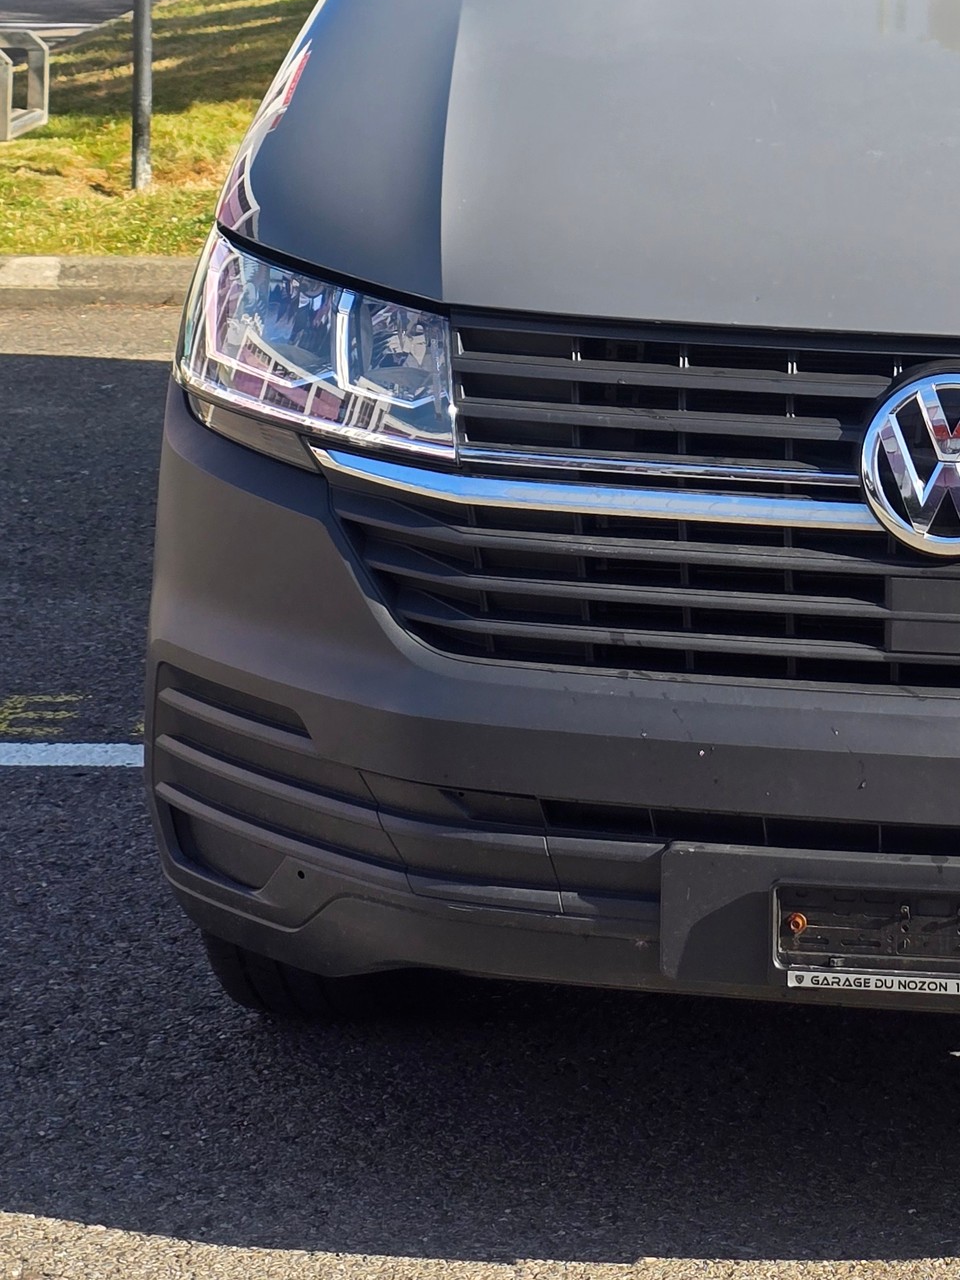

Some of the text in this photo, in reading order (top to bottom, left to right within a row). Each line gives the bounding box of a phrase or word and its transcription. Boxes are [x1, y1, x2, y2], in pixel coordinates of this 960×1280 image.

[810, 975, 871, 989] GARAGE
[874, 978, 894, 989] DU
[897, 980, 948, 992] NOZON
